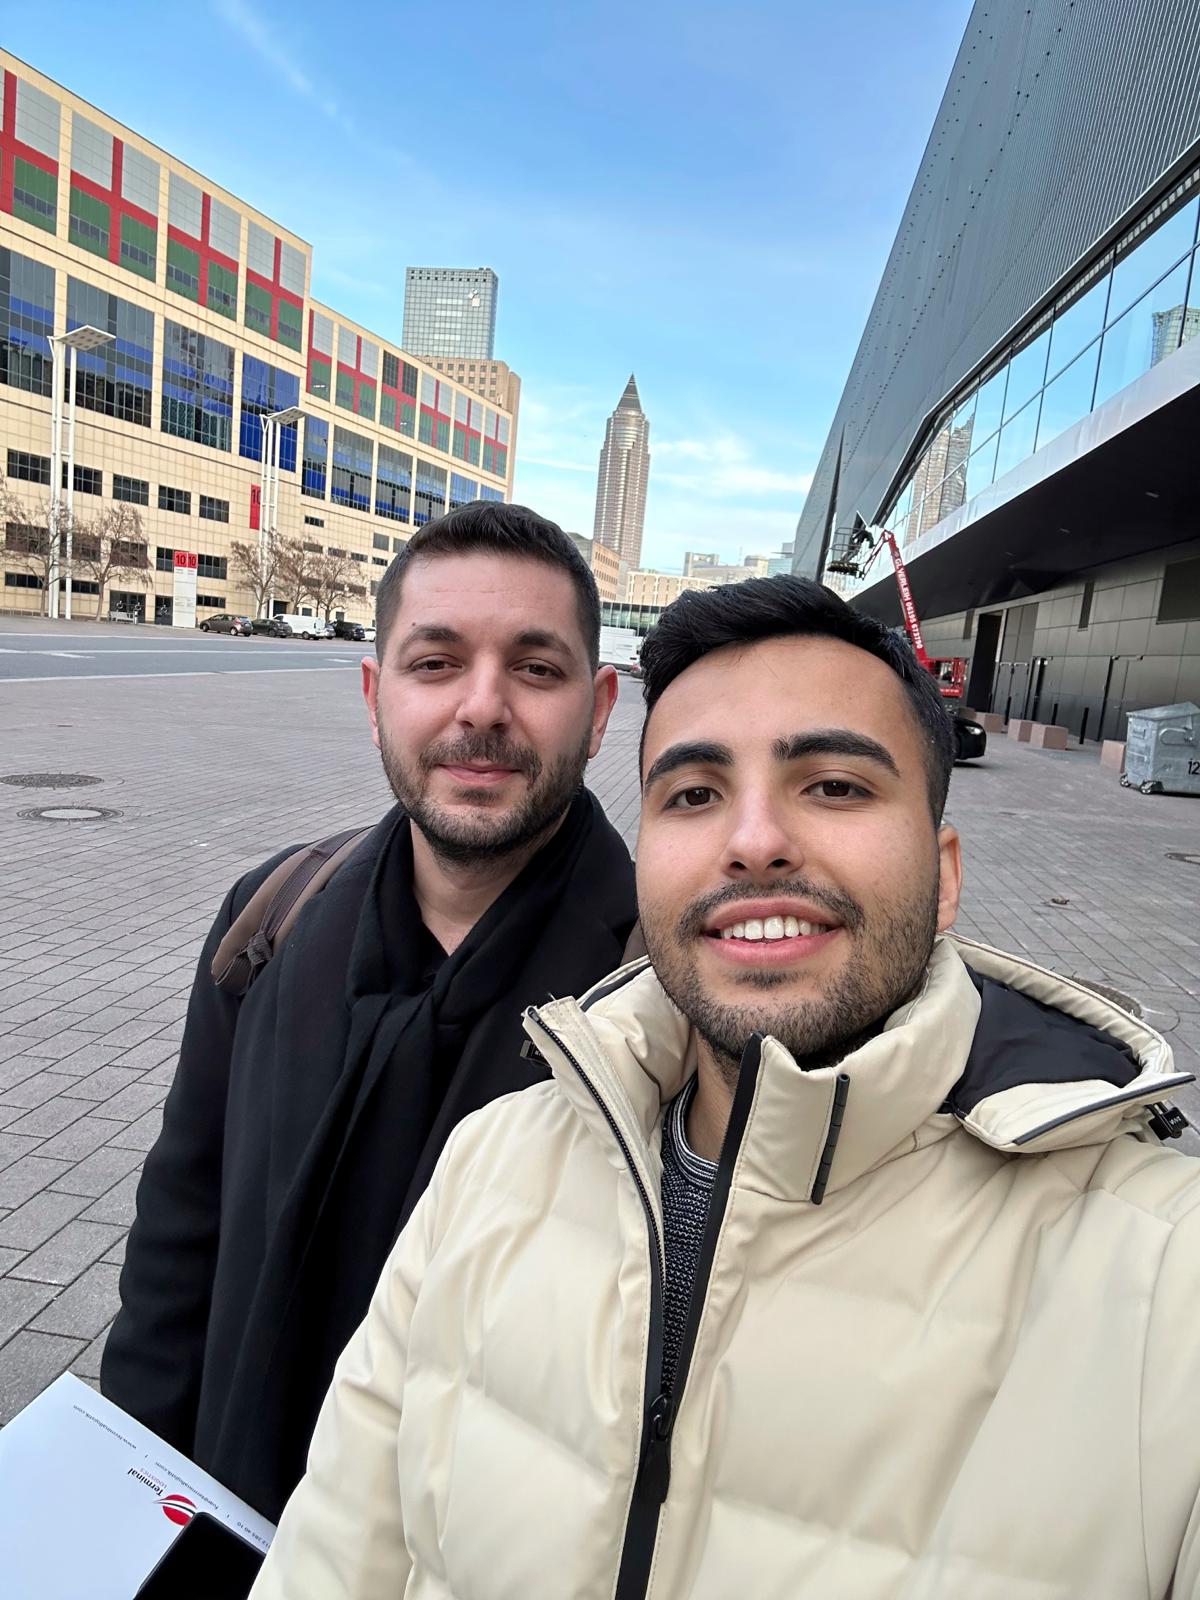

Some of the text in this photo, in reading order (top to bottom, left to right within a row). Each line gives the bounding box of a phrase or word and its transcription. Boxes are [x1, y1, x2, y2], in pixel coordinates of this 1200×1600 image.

[176, 555, 186, 565] 10
[188, 556, 196, 566] 10
[1187, 760, 1200, 775] 12
[127, 1467, 164, 1496] Terminal
